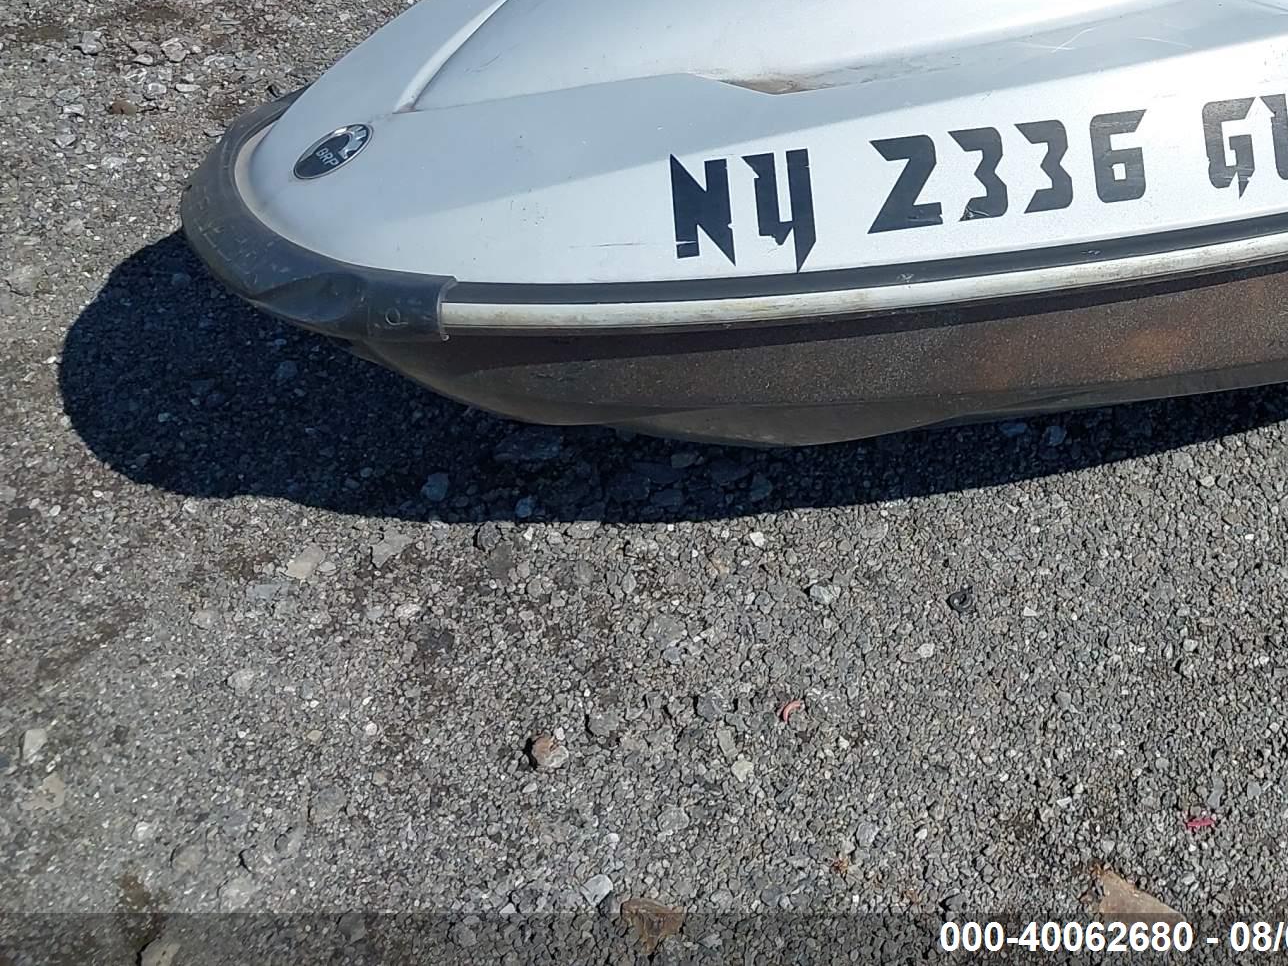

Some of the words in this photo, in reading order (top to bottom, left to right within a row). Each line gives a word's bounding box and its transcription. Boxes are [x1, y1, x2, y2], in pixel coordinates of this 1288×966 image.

[315, 147, 340, 166] BRP
[669, 148, 817, 274] NY
[868, 108, 1148, 234] 2336
